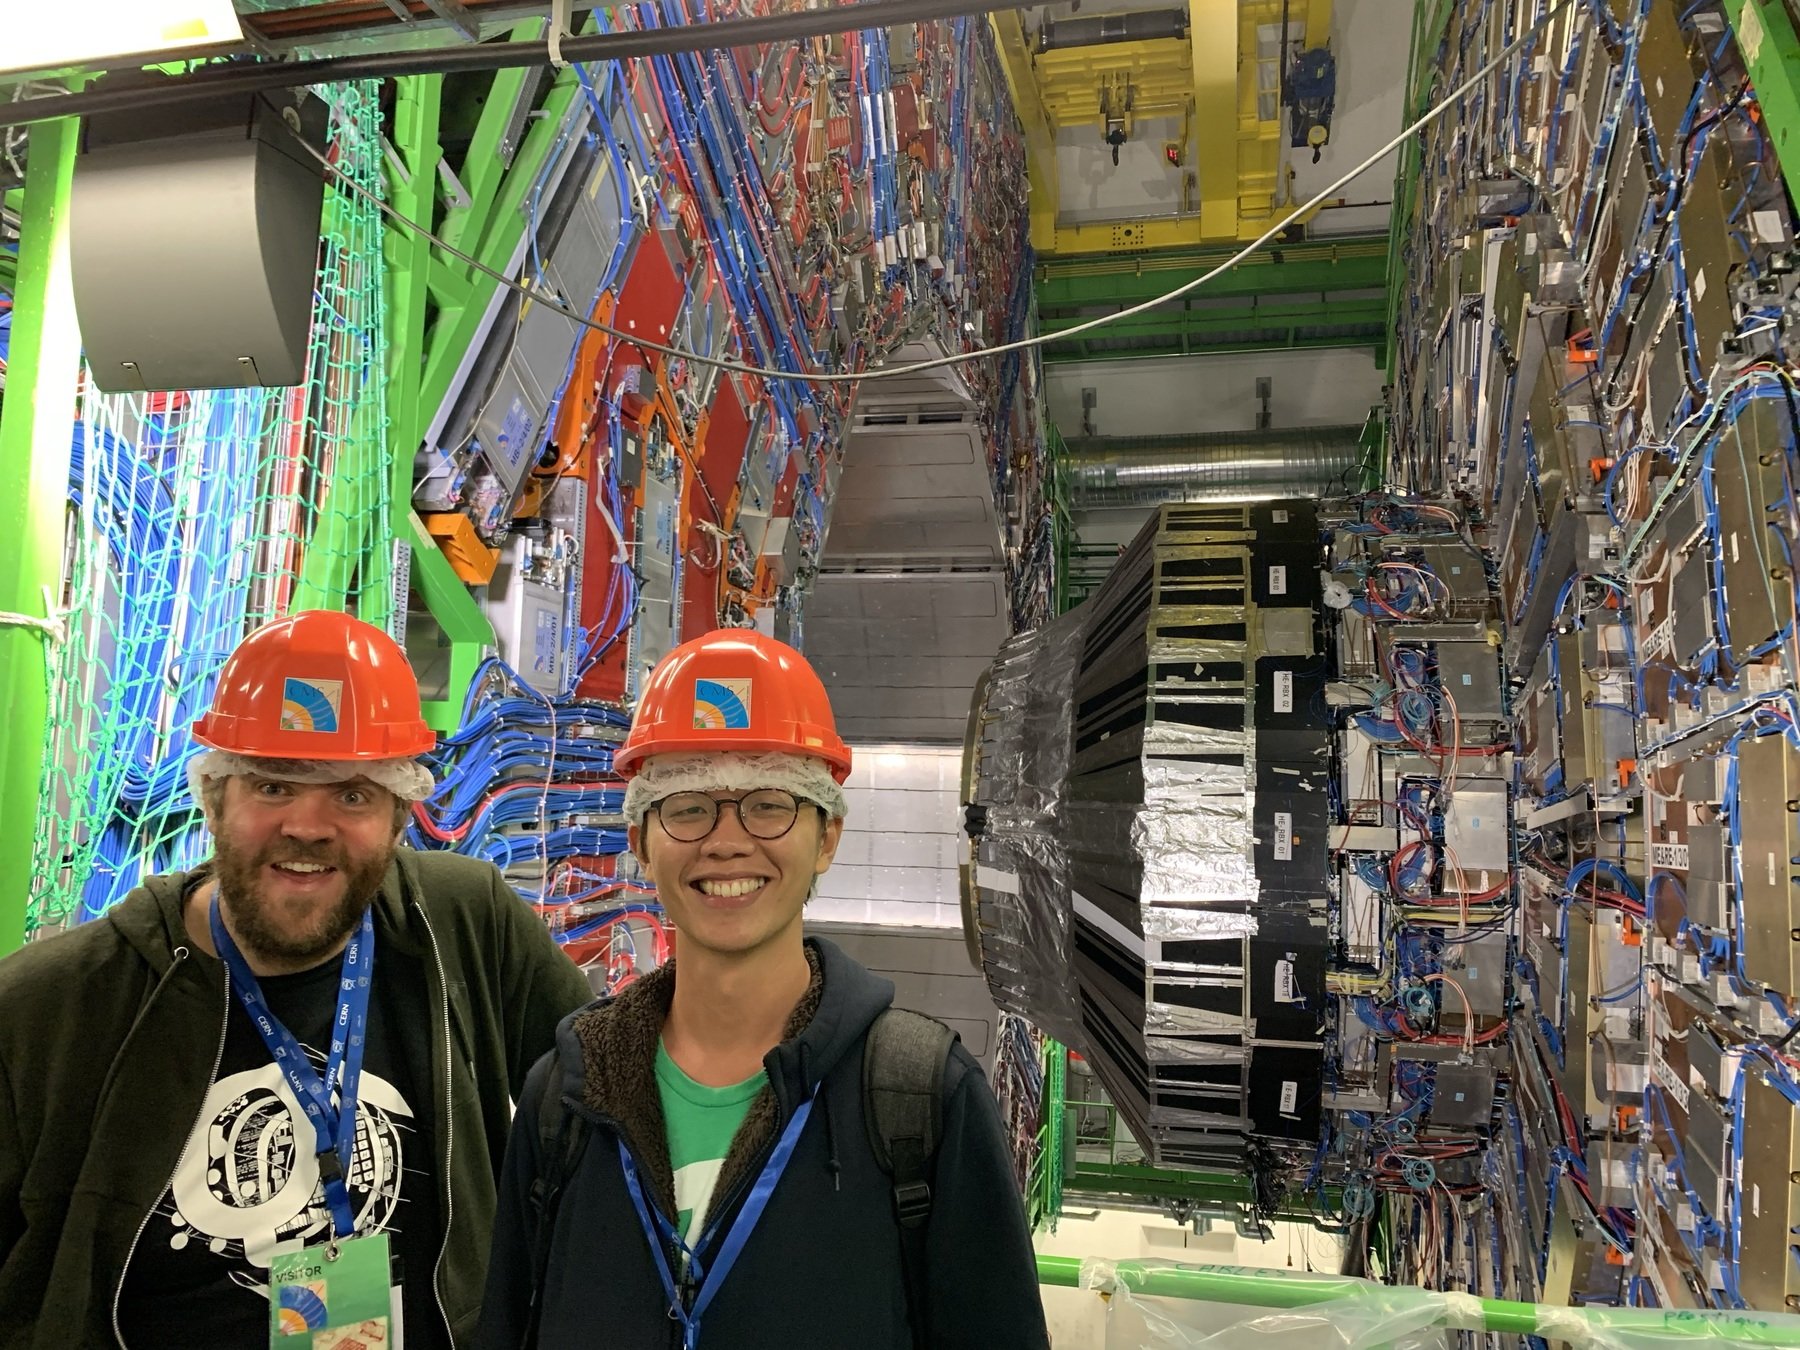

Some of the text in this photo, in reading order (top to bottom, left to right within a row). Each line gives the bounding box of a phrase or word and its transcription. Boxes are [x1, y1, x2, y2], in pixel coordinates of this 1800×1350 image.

[289, 685, 325, 698] CMS
[700, 684, 734, 697] CMS
[1282, 700, 1290, 708] 02
[348, 943, 359, 965] CERN
[339, 1003, 350, 1026] CERN
[258, 1015, 274, 1036] CERN
[326, 1067, 337, 1091] CERN
[276, 1265, 323, 1284] VISITOR
